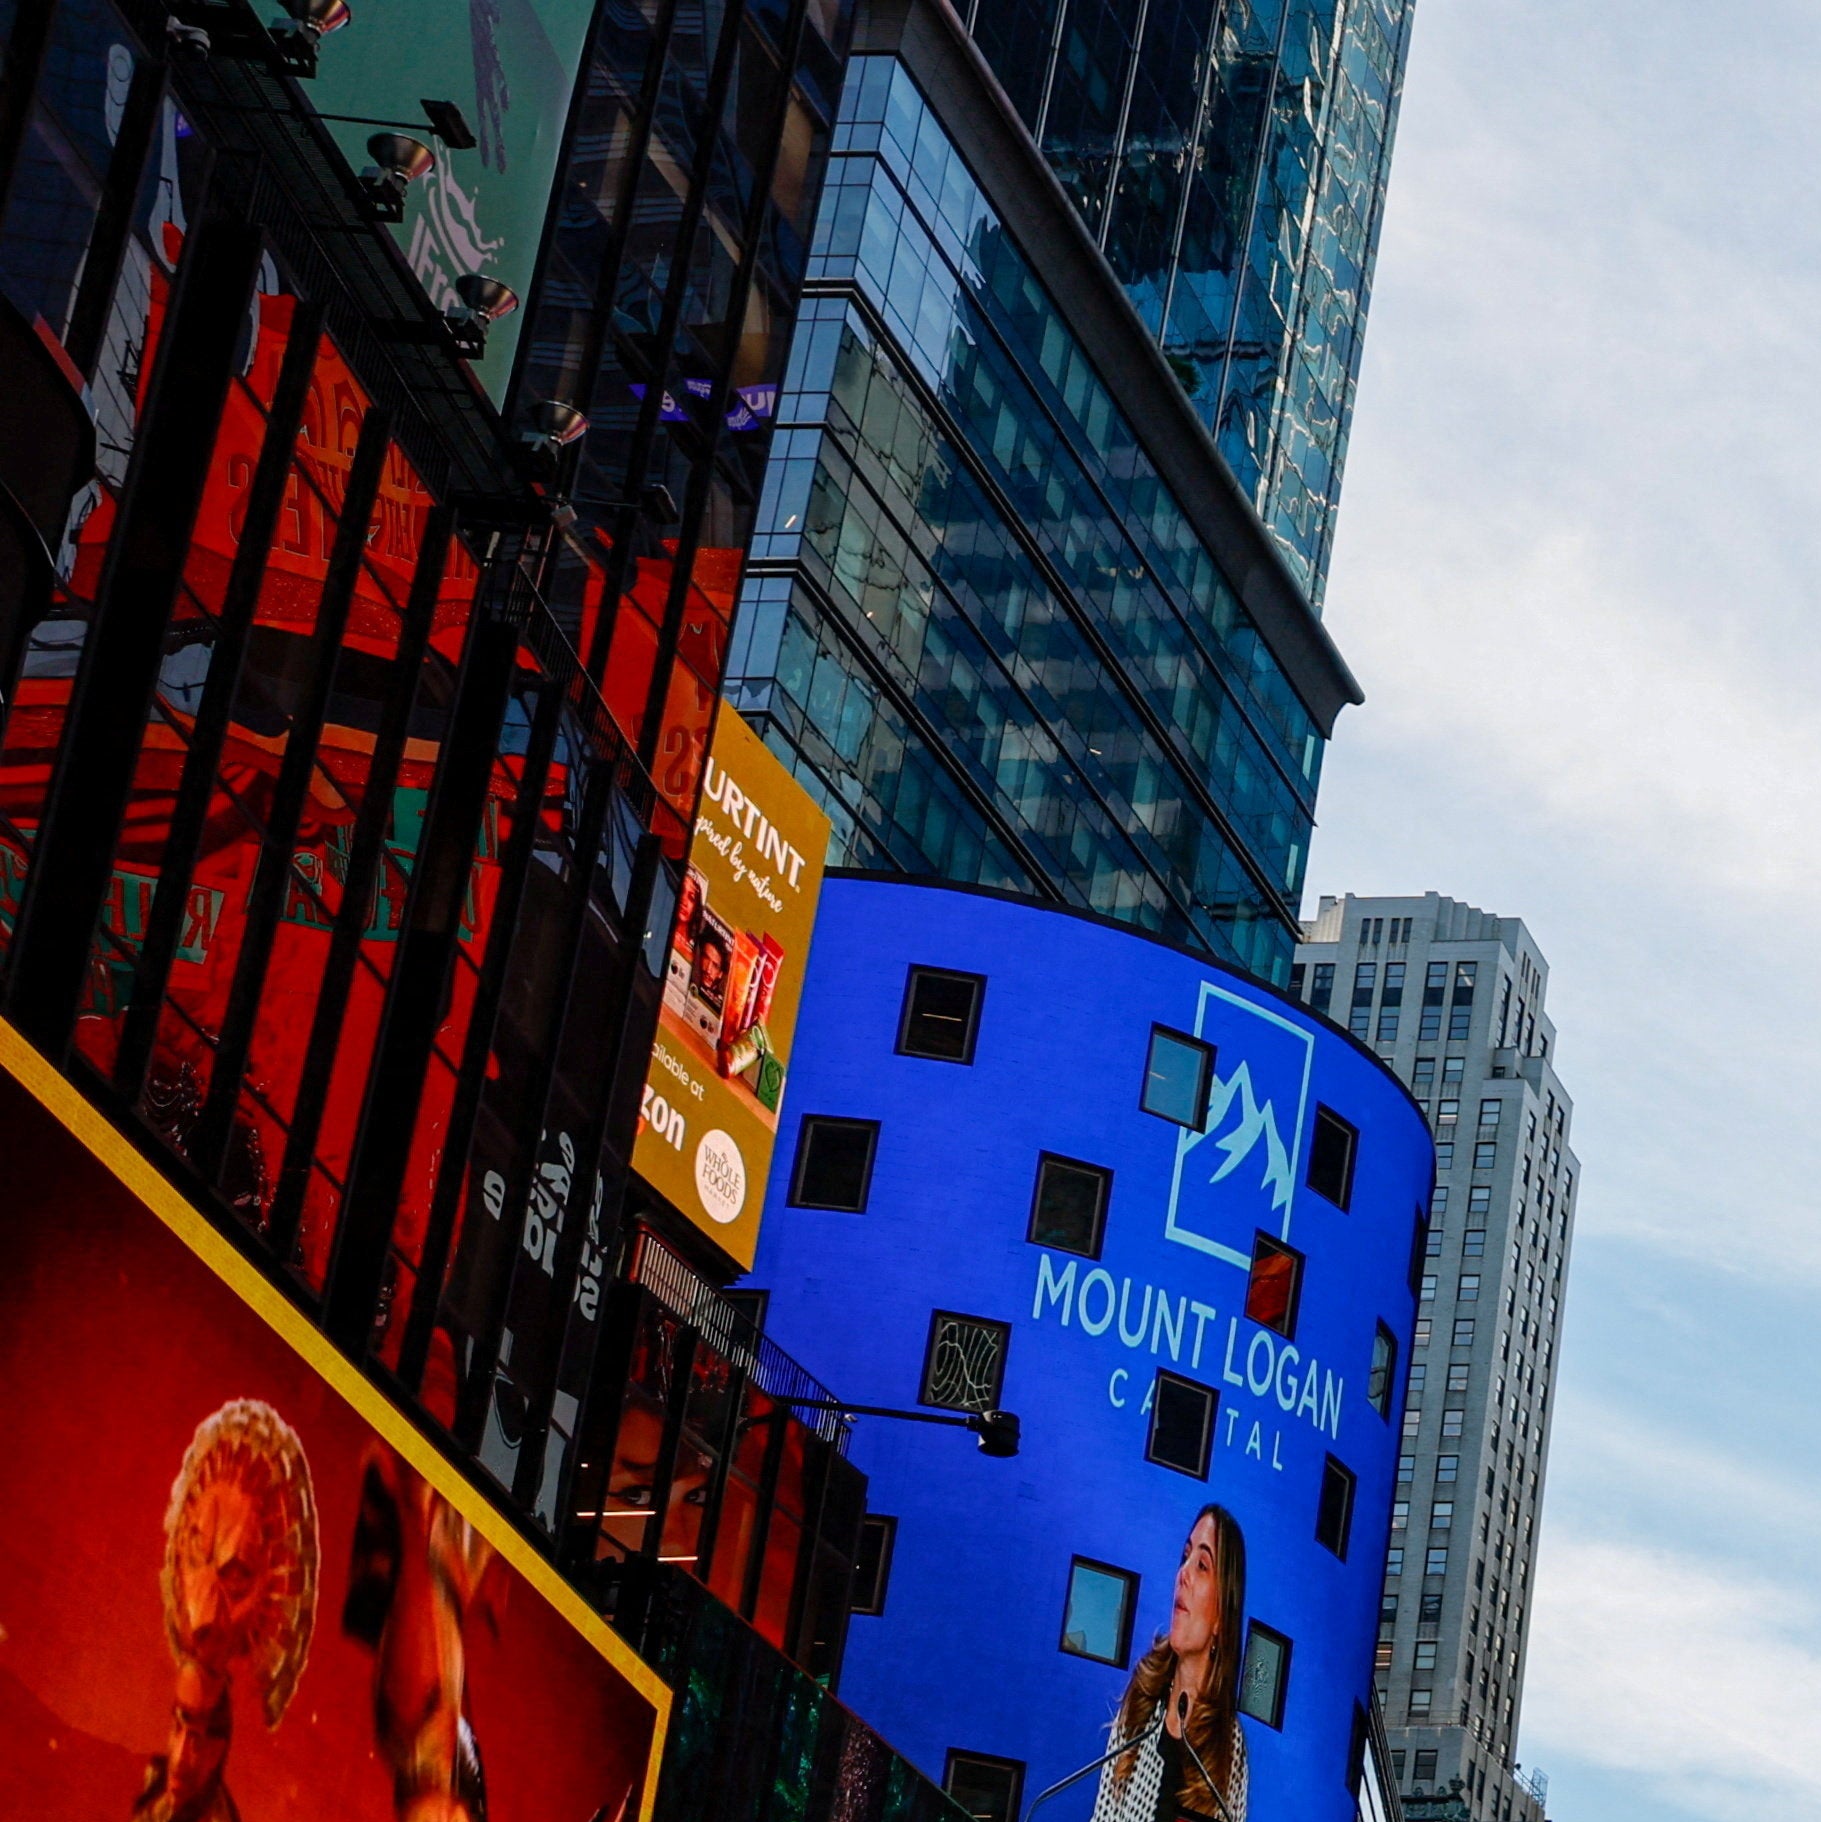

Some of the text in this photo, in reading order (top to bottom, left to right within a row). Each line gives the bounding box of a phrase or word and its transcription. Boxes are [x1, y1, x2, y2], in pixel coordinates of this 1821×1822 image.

[695, 813, 728, 859] pired
[746, 867, 782, 914] nature
[702, 756, 806, 894] URTINT.
[651, 1040, 705, 1101] ailable at
[702, 1148, 740, 1192] WHOLE
[702, 1164, 738, 1206] FOODS
[1032, 1253, 1344, 1440] MOUNT LOGAN
